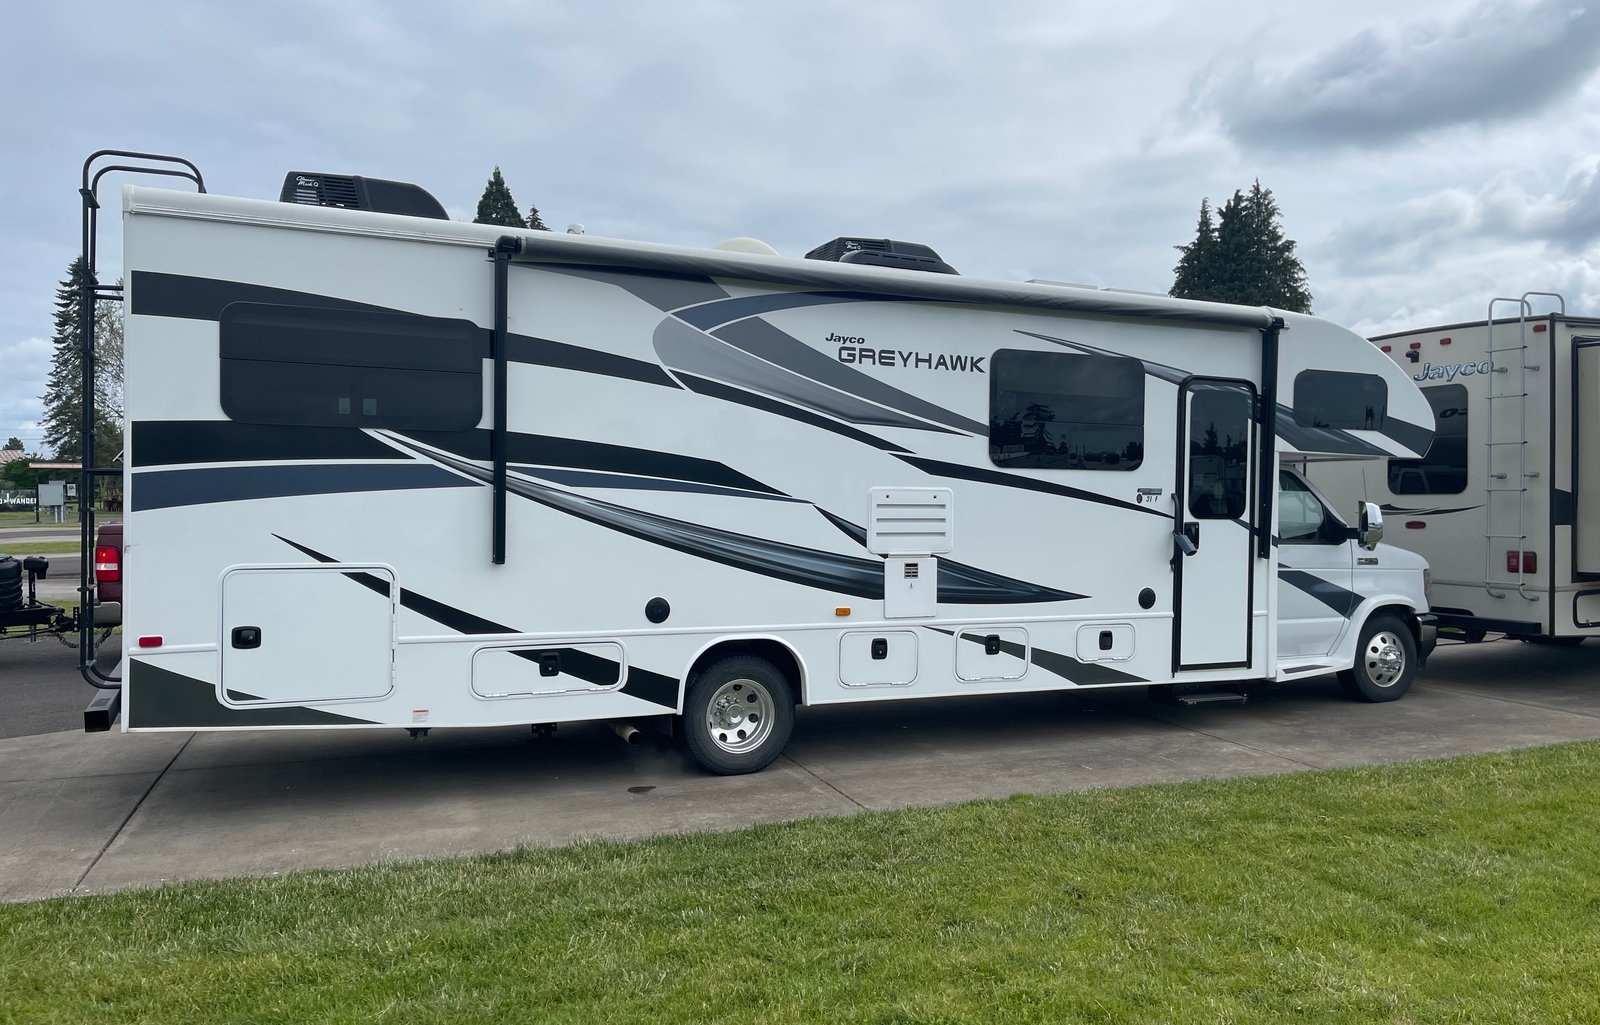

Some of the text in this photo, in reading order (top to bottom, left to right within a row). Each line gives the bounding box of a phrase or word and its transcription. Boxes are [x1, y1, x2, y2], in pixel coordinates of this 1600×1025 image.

[825, 332, 865, 345] Jayco
[838, 346, 986, 374] GREYHAWK
[1413, 359, 1494, 382] Jayco
